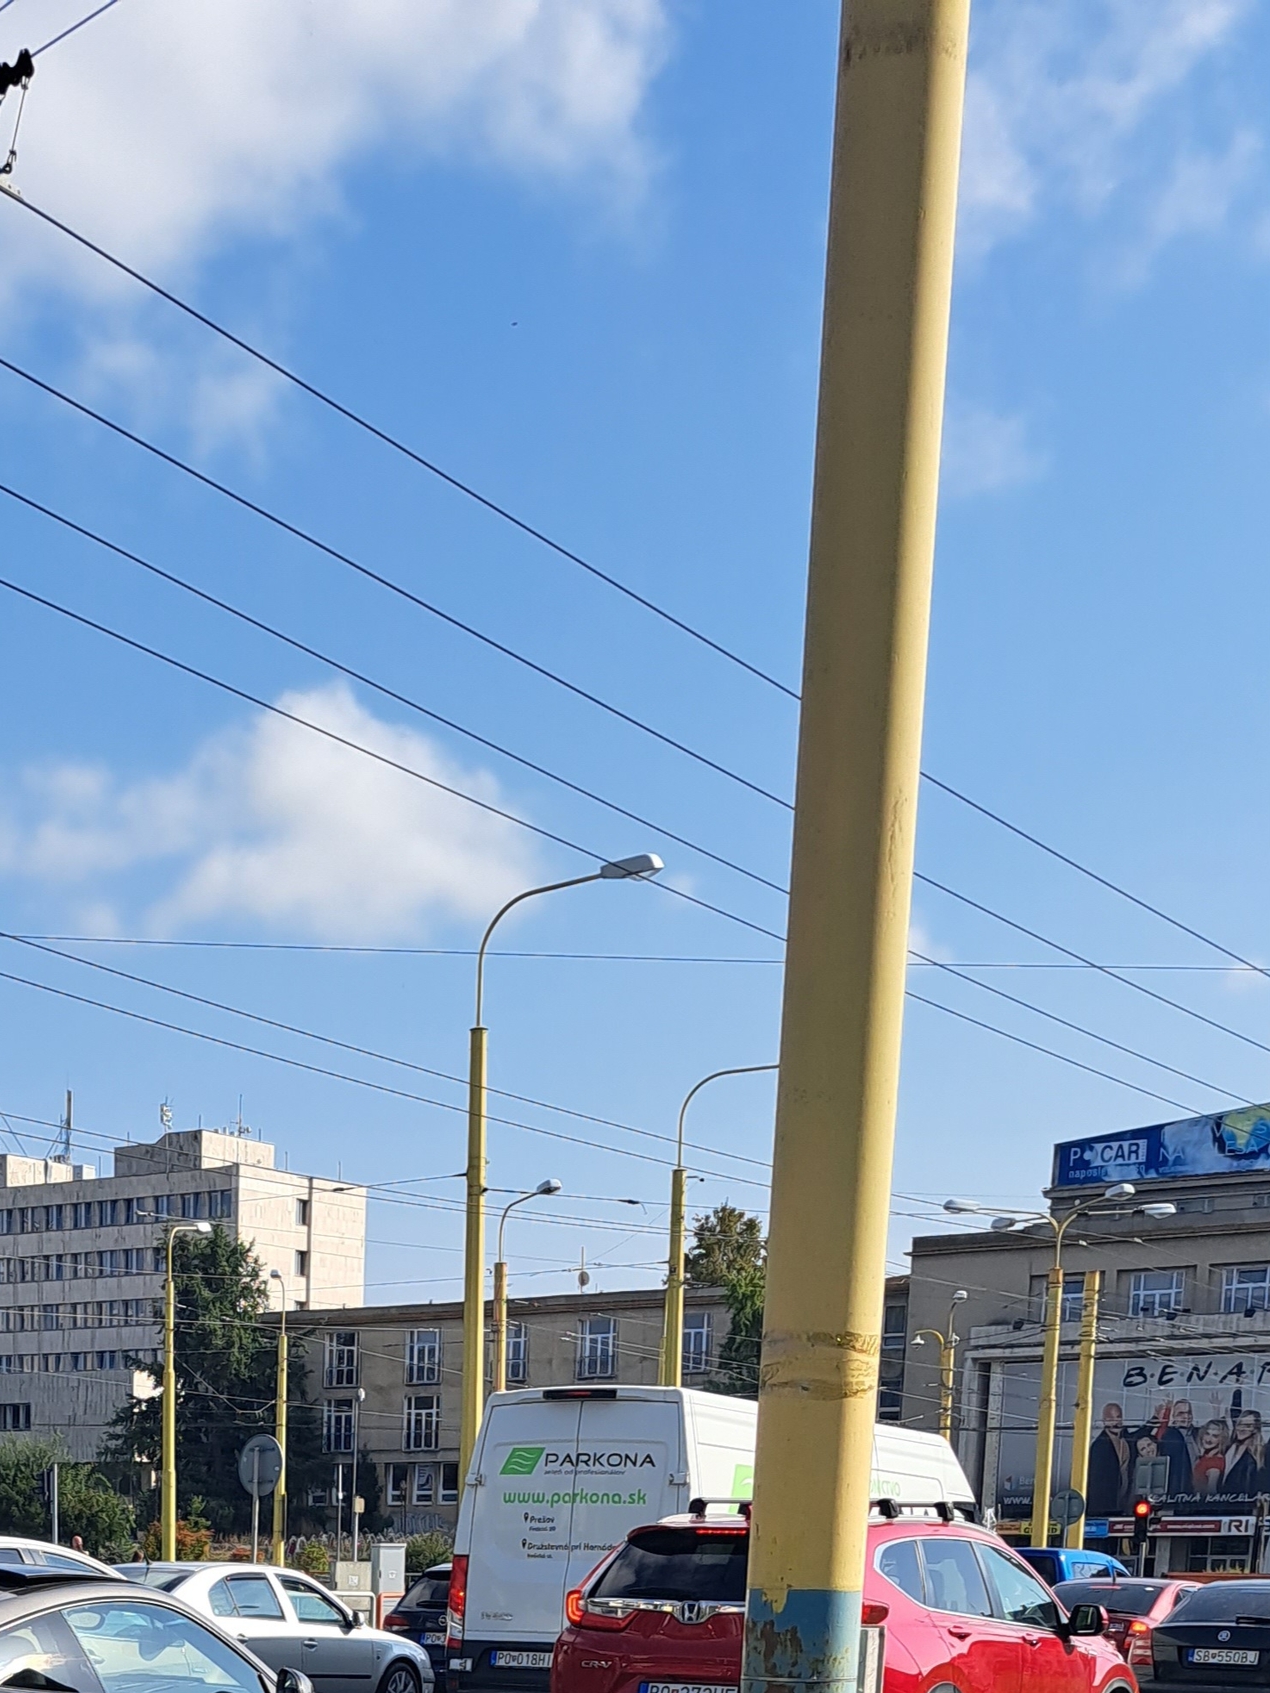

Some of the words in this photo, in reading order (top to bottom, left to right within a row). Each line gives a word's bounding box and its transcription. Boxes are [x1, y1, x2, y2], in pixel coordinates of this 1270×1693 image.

[544, 1451, 656, 1468] PARKONA
[503, 1488, 647, 1508] www.parkona.sk
[530, 1515, 556, 1524] Prešov
[497, 1651, 511, 1665] PO
[581, 1660, 612, 1669] CR-V
